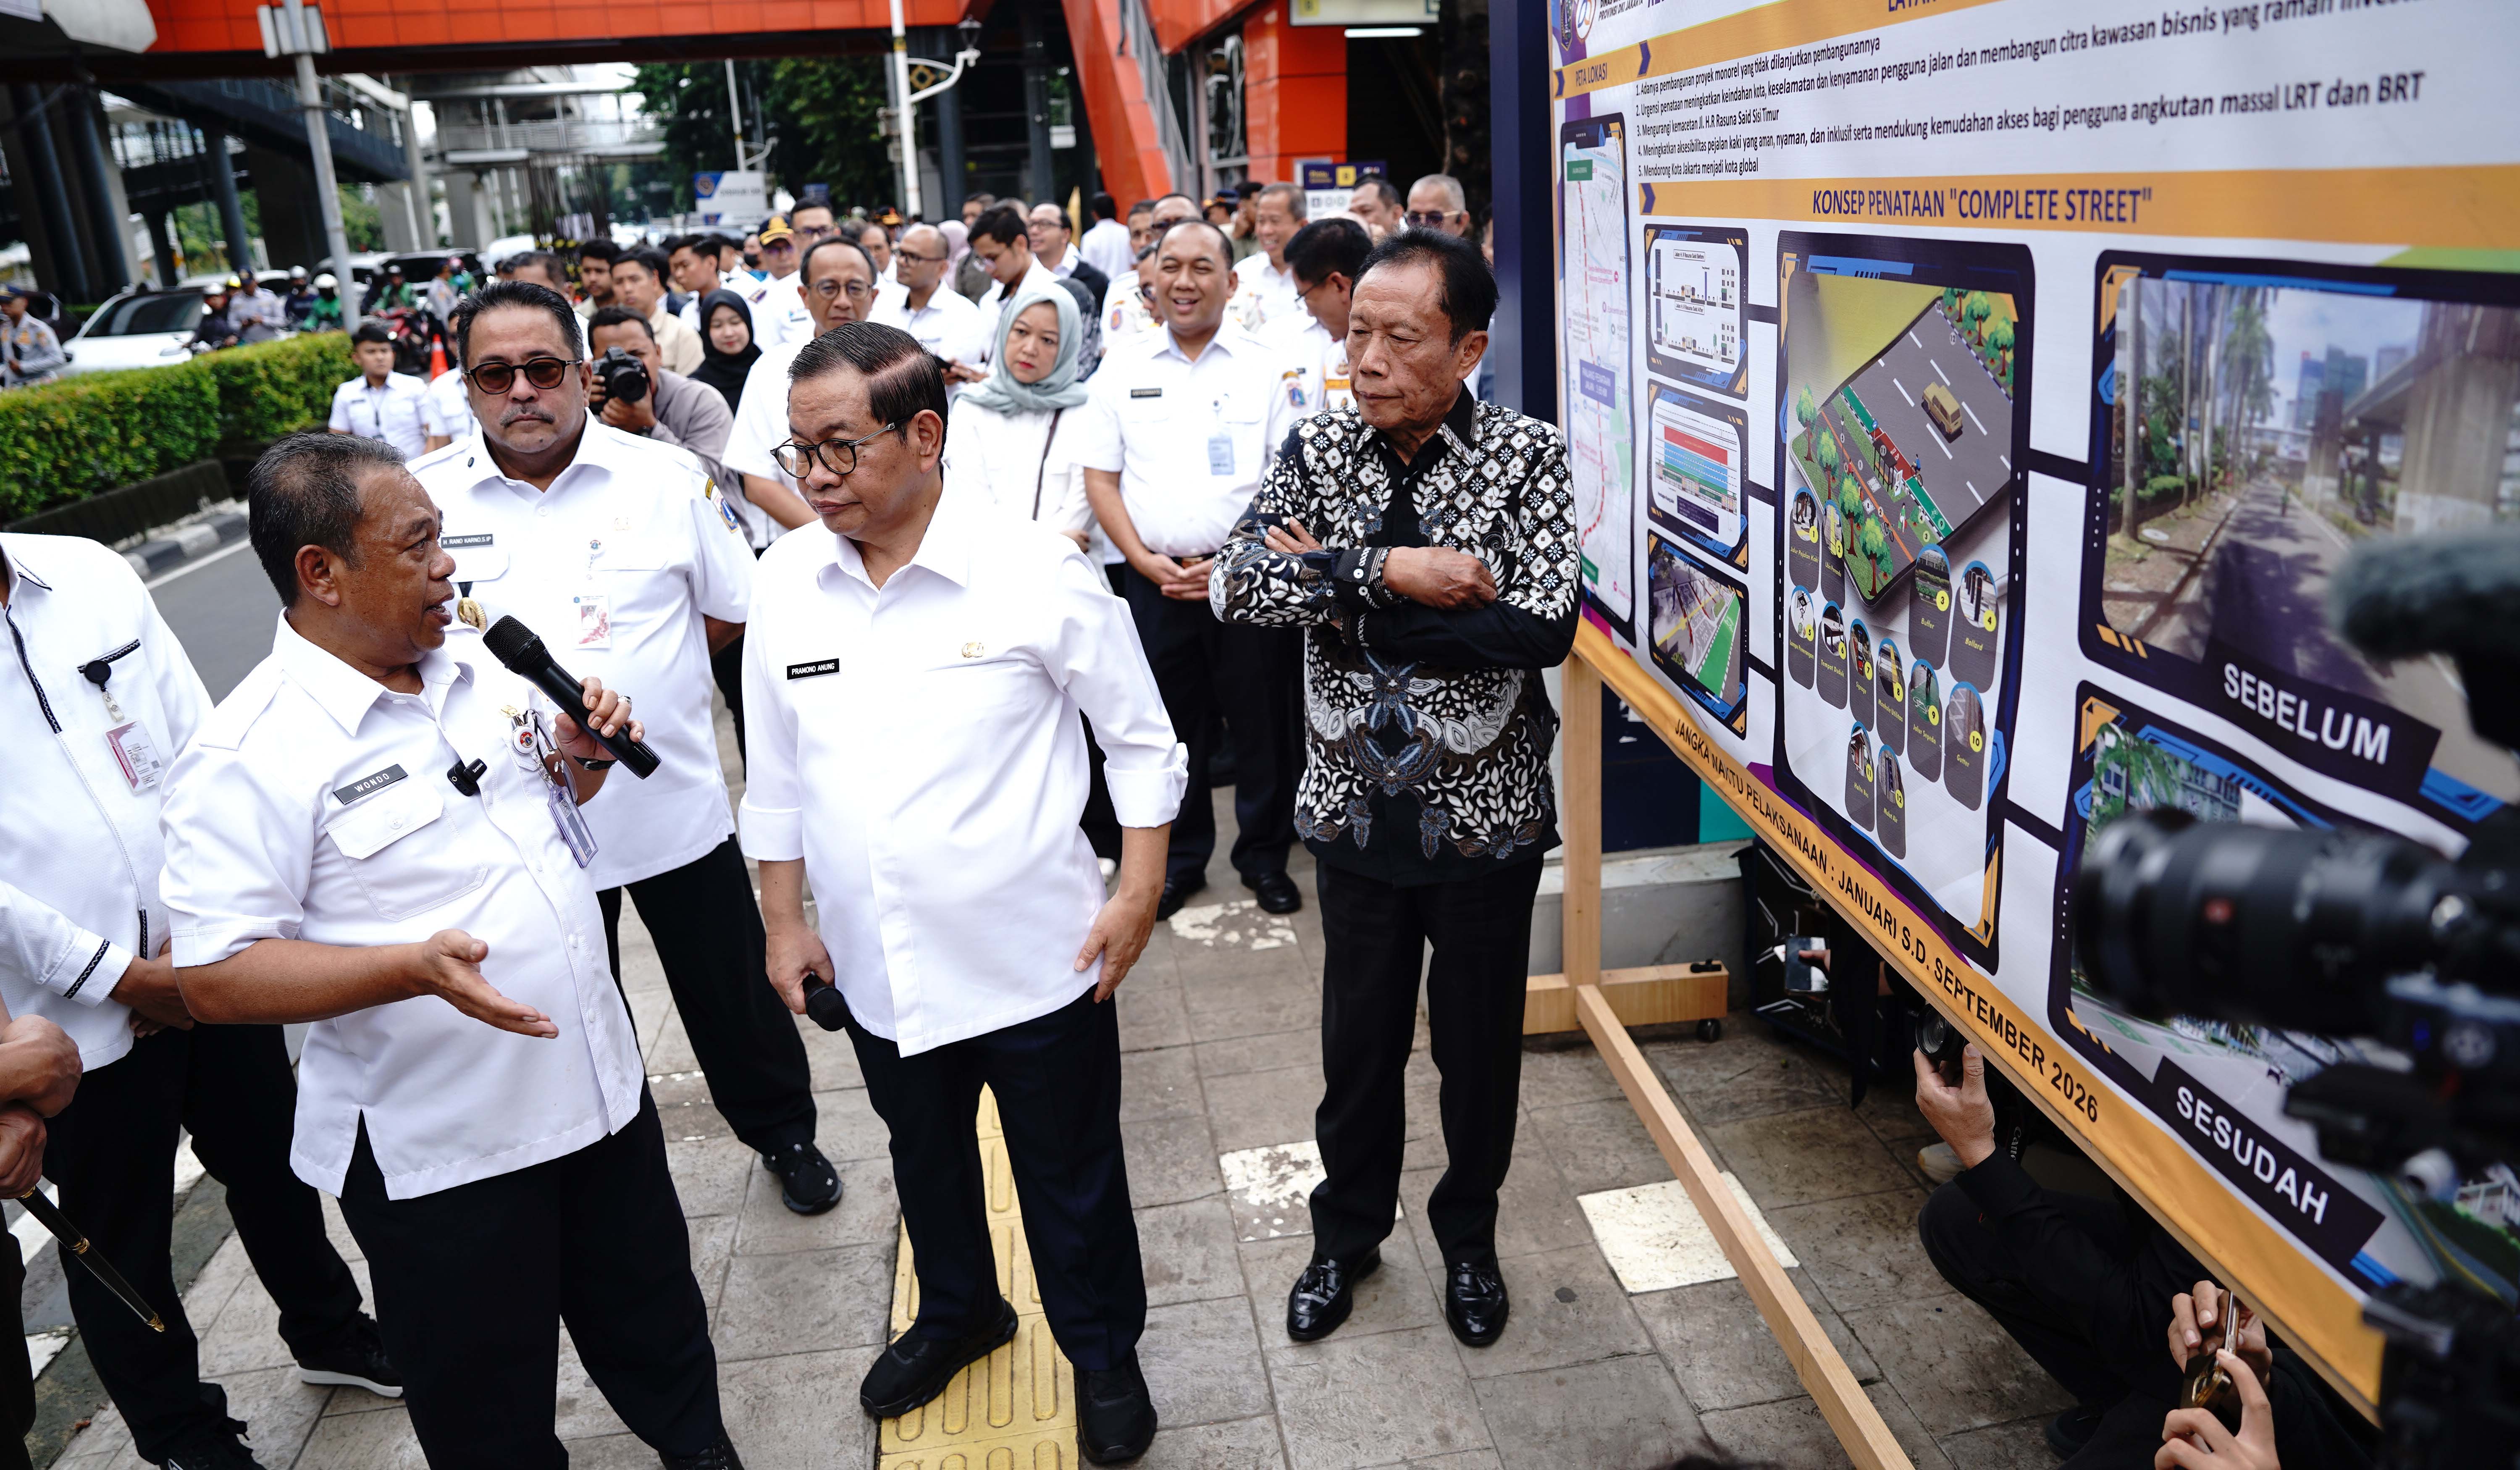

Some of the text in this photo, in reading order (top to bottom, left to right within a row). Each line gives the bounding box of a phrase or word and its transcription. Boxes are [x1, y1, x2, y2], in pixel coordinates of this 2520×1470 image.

[1636, 106, 1640, 117] 2.
[1641, 100, 1659, 118] Urgensi
[1661, 98, 1683, 116] penataan
[1684, 90, 1720, 111] meningkatkan
[1722, 85, 1752, 105] keindahan
[1754, 81, 1767, 100] kota,
[1768, 76, 1815, 96] keselamatan
[1816, 72, 1828, 89] dan
[1830, 68, 1878, 90] kenyamanan
[1882, 59, 1926, 83] pengguna
[1929, 52, 1953, 76] jalan
[1957, 47, 1976, 68] dan
[1980, 37, 2056, 64] membangun
[2060, 30, 2087, 52] citra
[2092, 20, 2155, 47] kawasan
[2161, 6, 2216, 37] bisnis
[2222, 4, 2259, 34] yang
[1636, 37, 1880, 96] 1. Adanya pembangunan proyek monorel yang tidak dilanjutkan pembangunannya
[1576, 63, 1607, 87] PETA LOKASI
[1637, 126, 1641, 136] 3.
[1642, 118, 1671, 137] Mengurangi
[1672, 116, 1698, 132] kemacetan
[1706, 113, 1715, 128] H.R
[1716, 110, 1737, 127] Rasuna
[1738, 107, 1751, 123] Said
[1752, 108, 1762, 122] Sisi
[1762, 107, 1779, 122] Timur
[1638, 71, 2426, 159] 4. Meningkatkan aksesibilitas pejalan kaki yang aman, nyaman, dan inklusif serta mendukung kemudahan akses bagi pengguna angkutan massal LRT dan BRT
[1638, 157, 1759, 180] 5. Mendorong Kota Jakarta menjadi kota global
[1812, 186, 2152, 223] KONSEP PENATAAN "COMPLETE STREET"
[1798, 549, 1810, 559] Pejalan
[1940, 596, 1945, 605] 3
[1921, 617, 1935, 629] Buffer
[1987, 617, 1992, 625] 4
[1965, 637, 1983, 651] Bollard
[792, 663, 835, 675] PRAMONO ANUNG
[1821, 659, 1845, 677] Tempat Duduk
[1856, 681, 1867, 694] Signage
[1878, 698, 1903, 722] Manhole Utilitas
[2223, 662, 2391, 766] SEBELUM
[1913, 724, 1936, 745] Jalur Sepeda
[1972, 735, 1980, 747] 10
[1867, 768, 1871, 777] 11
[354, 773, 390, 792] WONDO
[1854, 782, 1863, 793] Halte
[1897, 793, 1902, 804] 12
[1675, 719, 1709, 759] JANGKA
[1747, 783, 1827, 874] PELAKSANAAN
[1832, 866, 1835, 882] :
[1838, 870, 1896, 940] JANUARI
[1902, 926, 1930, 971] S.D.
[1935, 957, 2045, 1076] SEPTEMBER
[2051, 1062, 2098, 1124] 2026
[2176, 1086, 2329, 1226] SESUDAH
